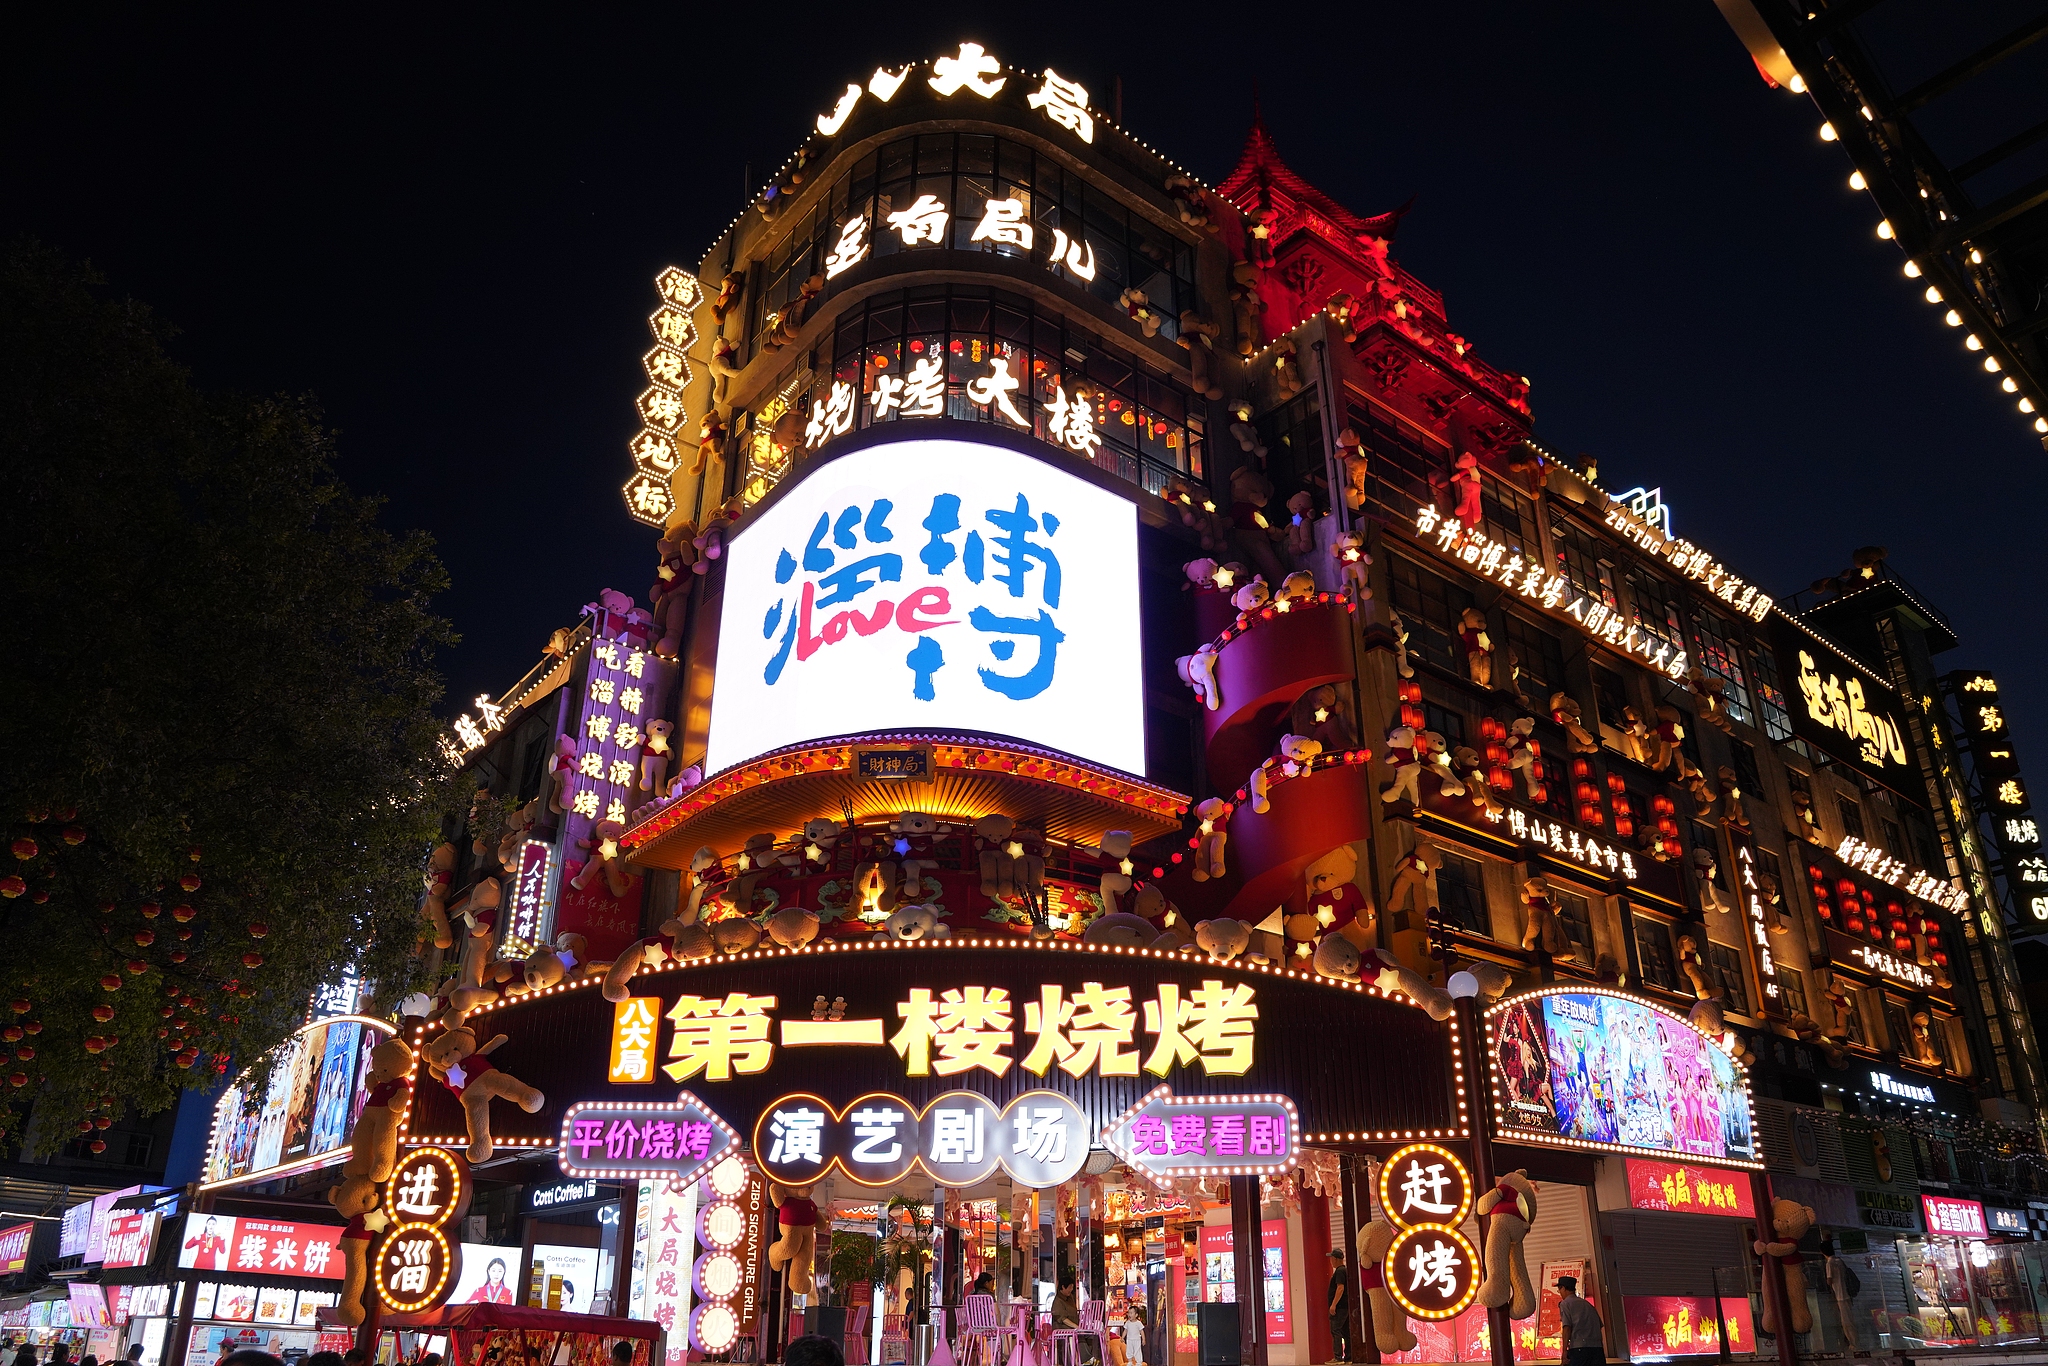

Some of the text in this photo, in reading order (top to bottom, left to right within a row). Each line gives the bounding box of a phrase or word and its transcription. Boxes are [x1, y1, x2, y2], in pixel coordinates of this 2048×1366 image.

[816, 42, 1095, 145] 八大局
[632, 271, 695, 516] 淄博烧烤地标
[804, 358, 1102, 459] 烧烤大楼
[1604, 509, 1662, 556] ZBCTDG
[763, 492, 1066, 702] 淄博
[573, 645, 621, 820] 吃淄博烧烤
[605, 651, 647, 825] 看精彩演出
[868, 756, 919, 773] 財神局
[1508, 807, 1638, 880] 博山菜美食市集
[1766, 982, 1779, 998] 4F
[613, 999, 652, 1083] 八大局
[661, 979, 1261, 1083] 第一楼烧烤
[568, 1118, 714, 1163] 平价烧烤
[767, 1104, 1071, 1169] 演艺剧场
[1130, 1112, 1290, 1159] 免费看剧
[533, 1188, 554, 1207] Cotti
[554, 1183, 584, 1203] Coffee
[1936, 1201, 1984, 1234] 蜜雪冰城
[236, 1233, 331, 1274] 紫米饼
[742, 1180, 762, 1324] ZIBO SIGNATURE GRILL
